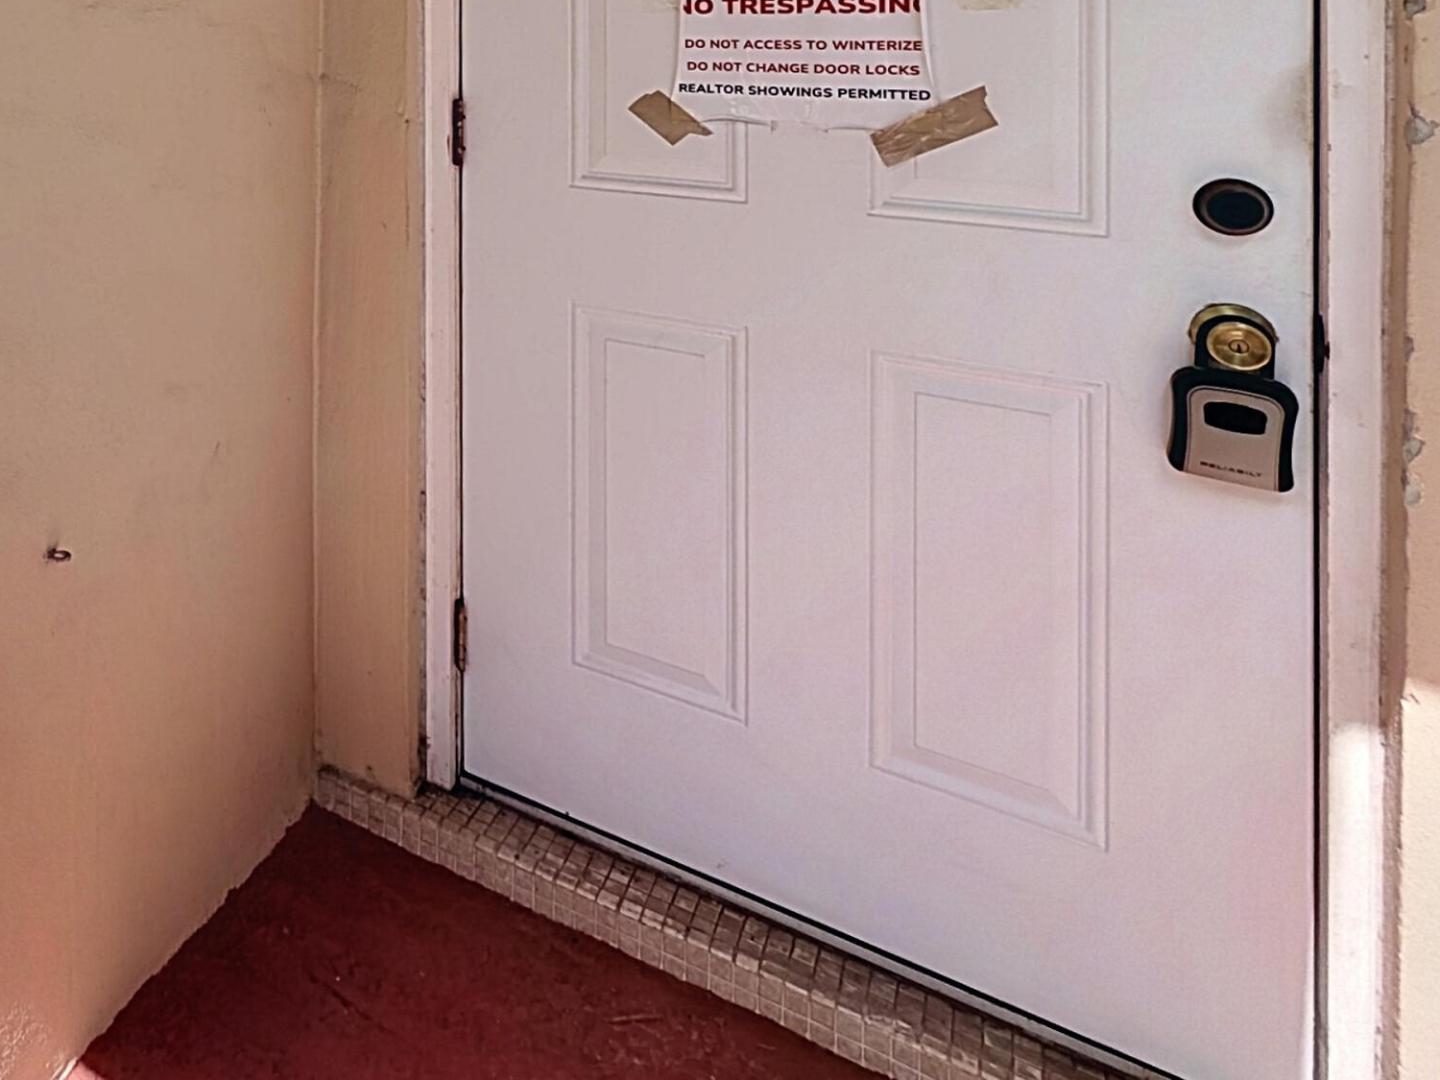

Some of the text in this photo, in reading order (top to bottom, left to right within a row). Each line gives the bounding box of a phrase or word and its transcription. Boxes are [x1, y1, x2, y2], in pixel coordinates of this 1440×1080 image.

[685, 39, 922, 51] DO NOT ACCESS TO WINTERIZE
[687, 61, 920, 76] DO NOT CHANGE DOOR LOCKS
[679, 83, 931, 101] REALTOR SHOWINGS PERMITTED
